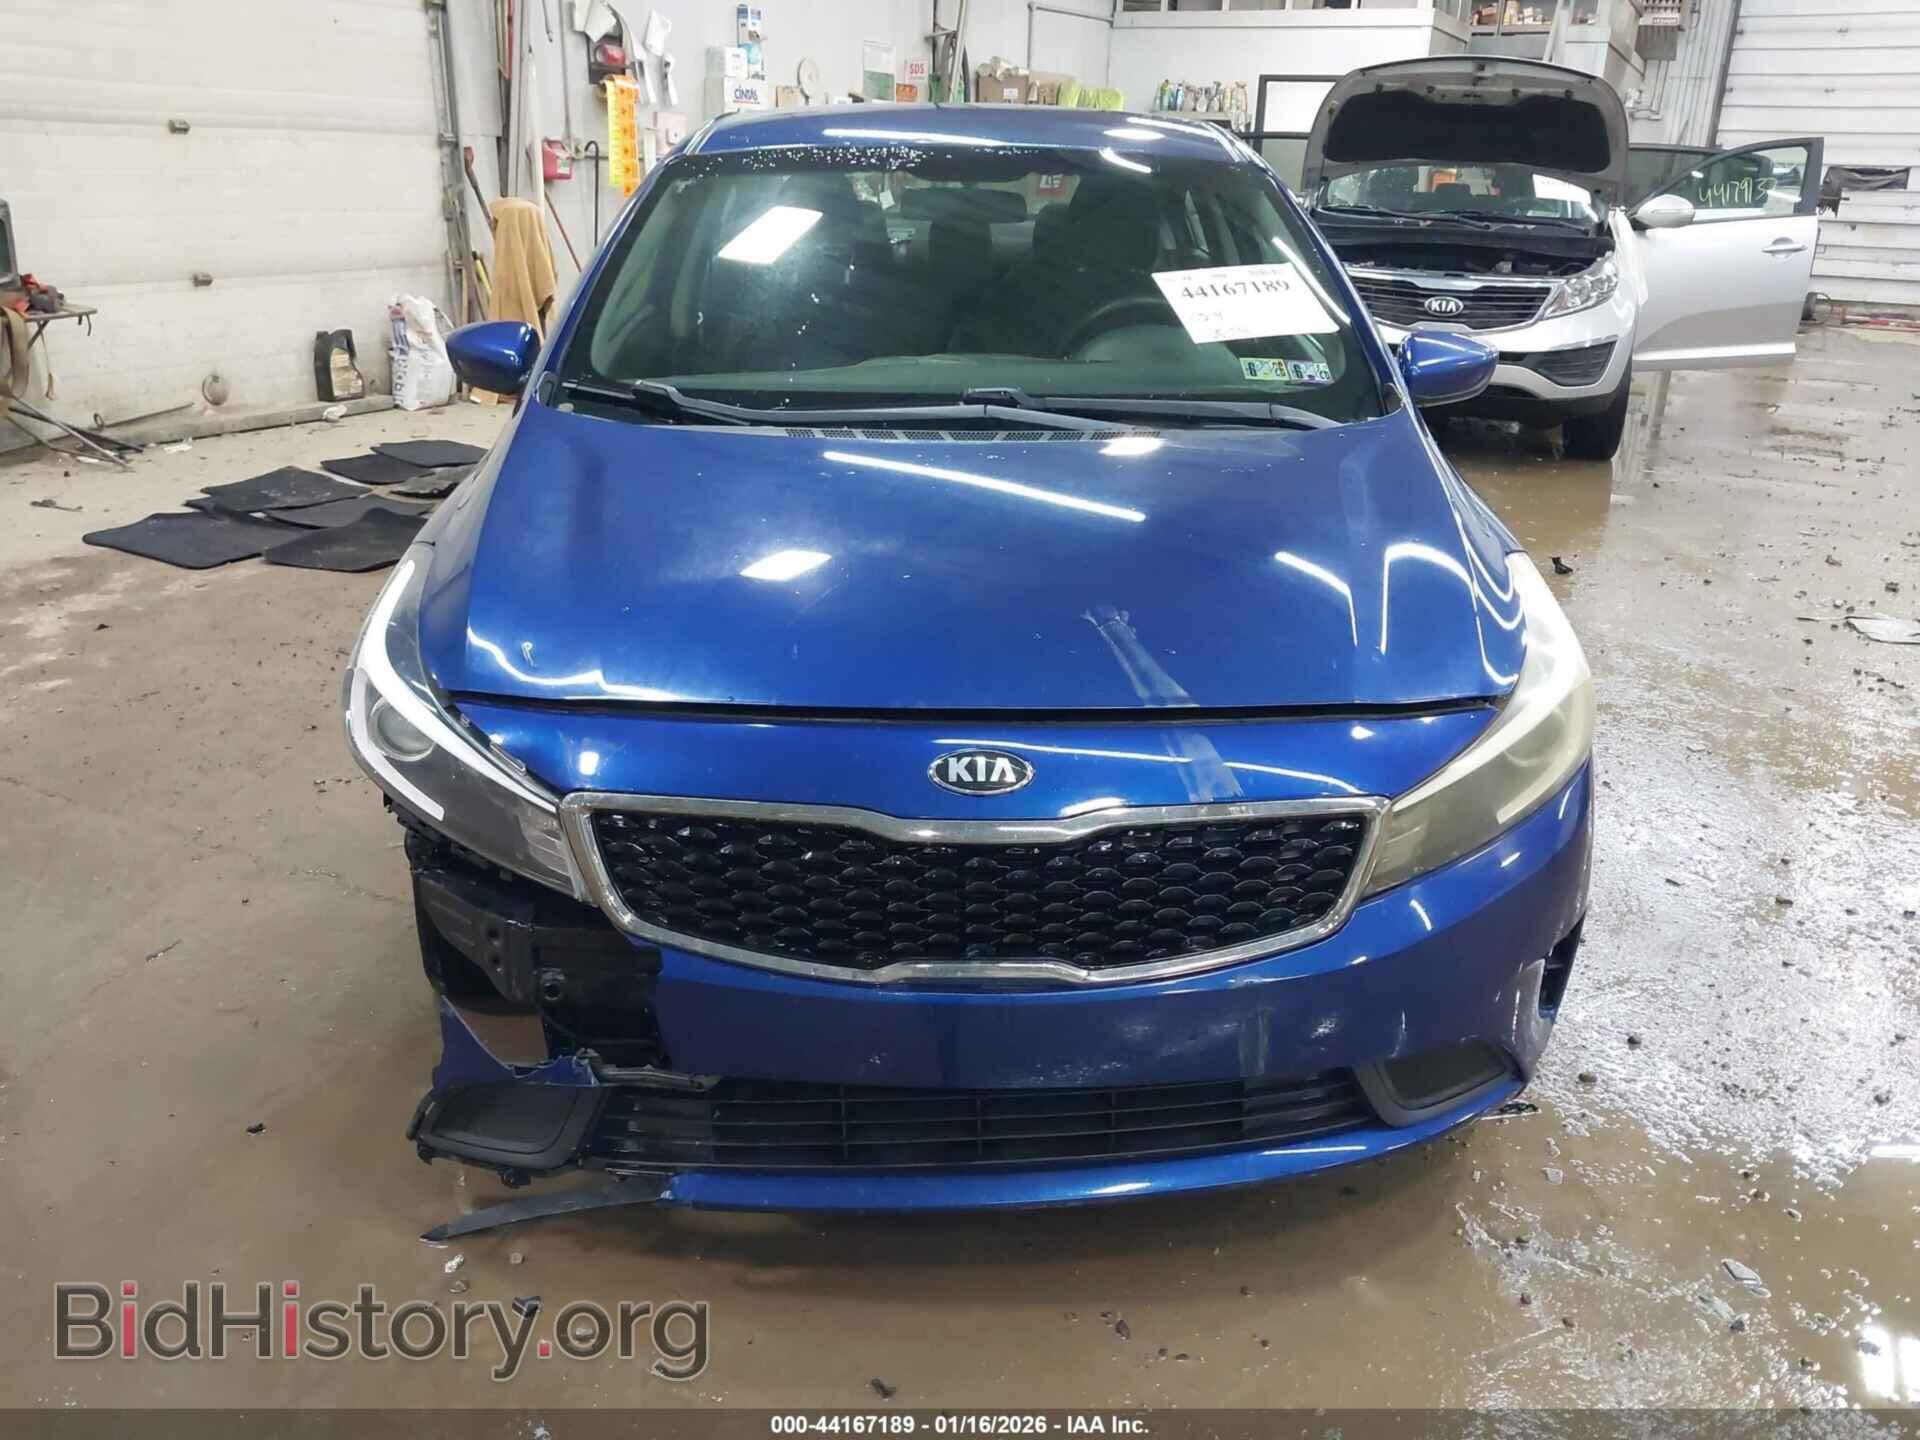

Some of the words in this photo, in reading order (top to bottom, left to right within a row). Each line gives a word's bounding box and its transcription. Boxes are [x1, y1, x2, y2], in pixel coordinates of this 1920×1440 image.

[1181, 279, 1290, 299] 44167189
[1431, 299, 1457, 312] KIA
[947, 756, 1017, 783] KIA
